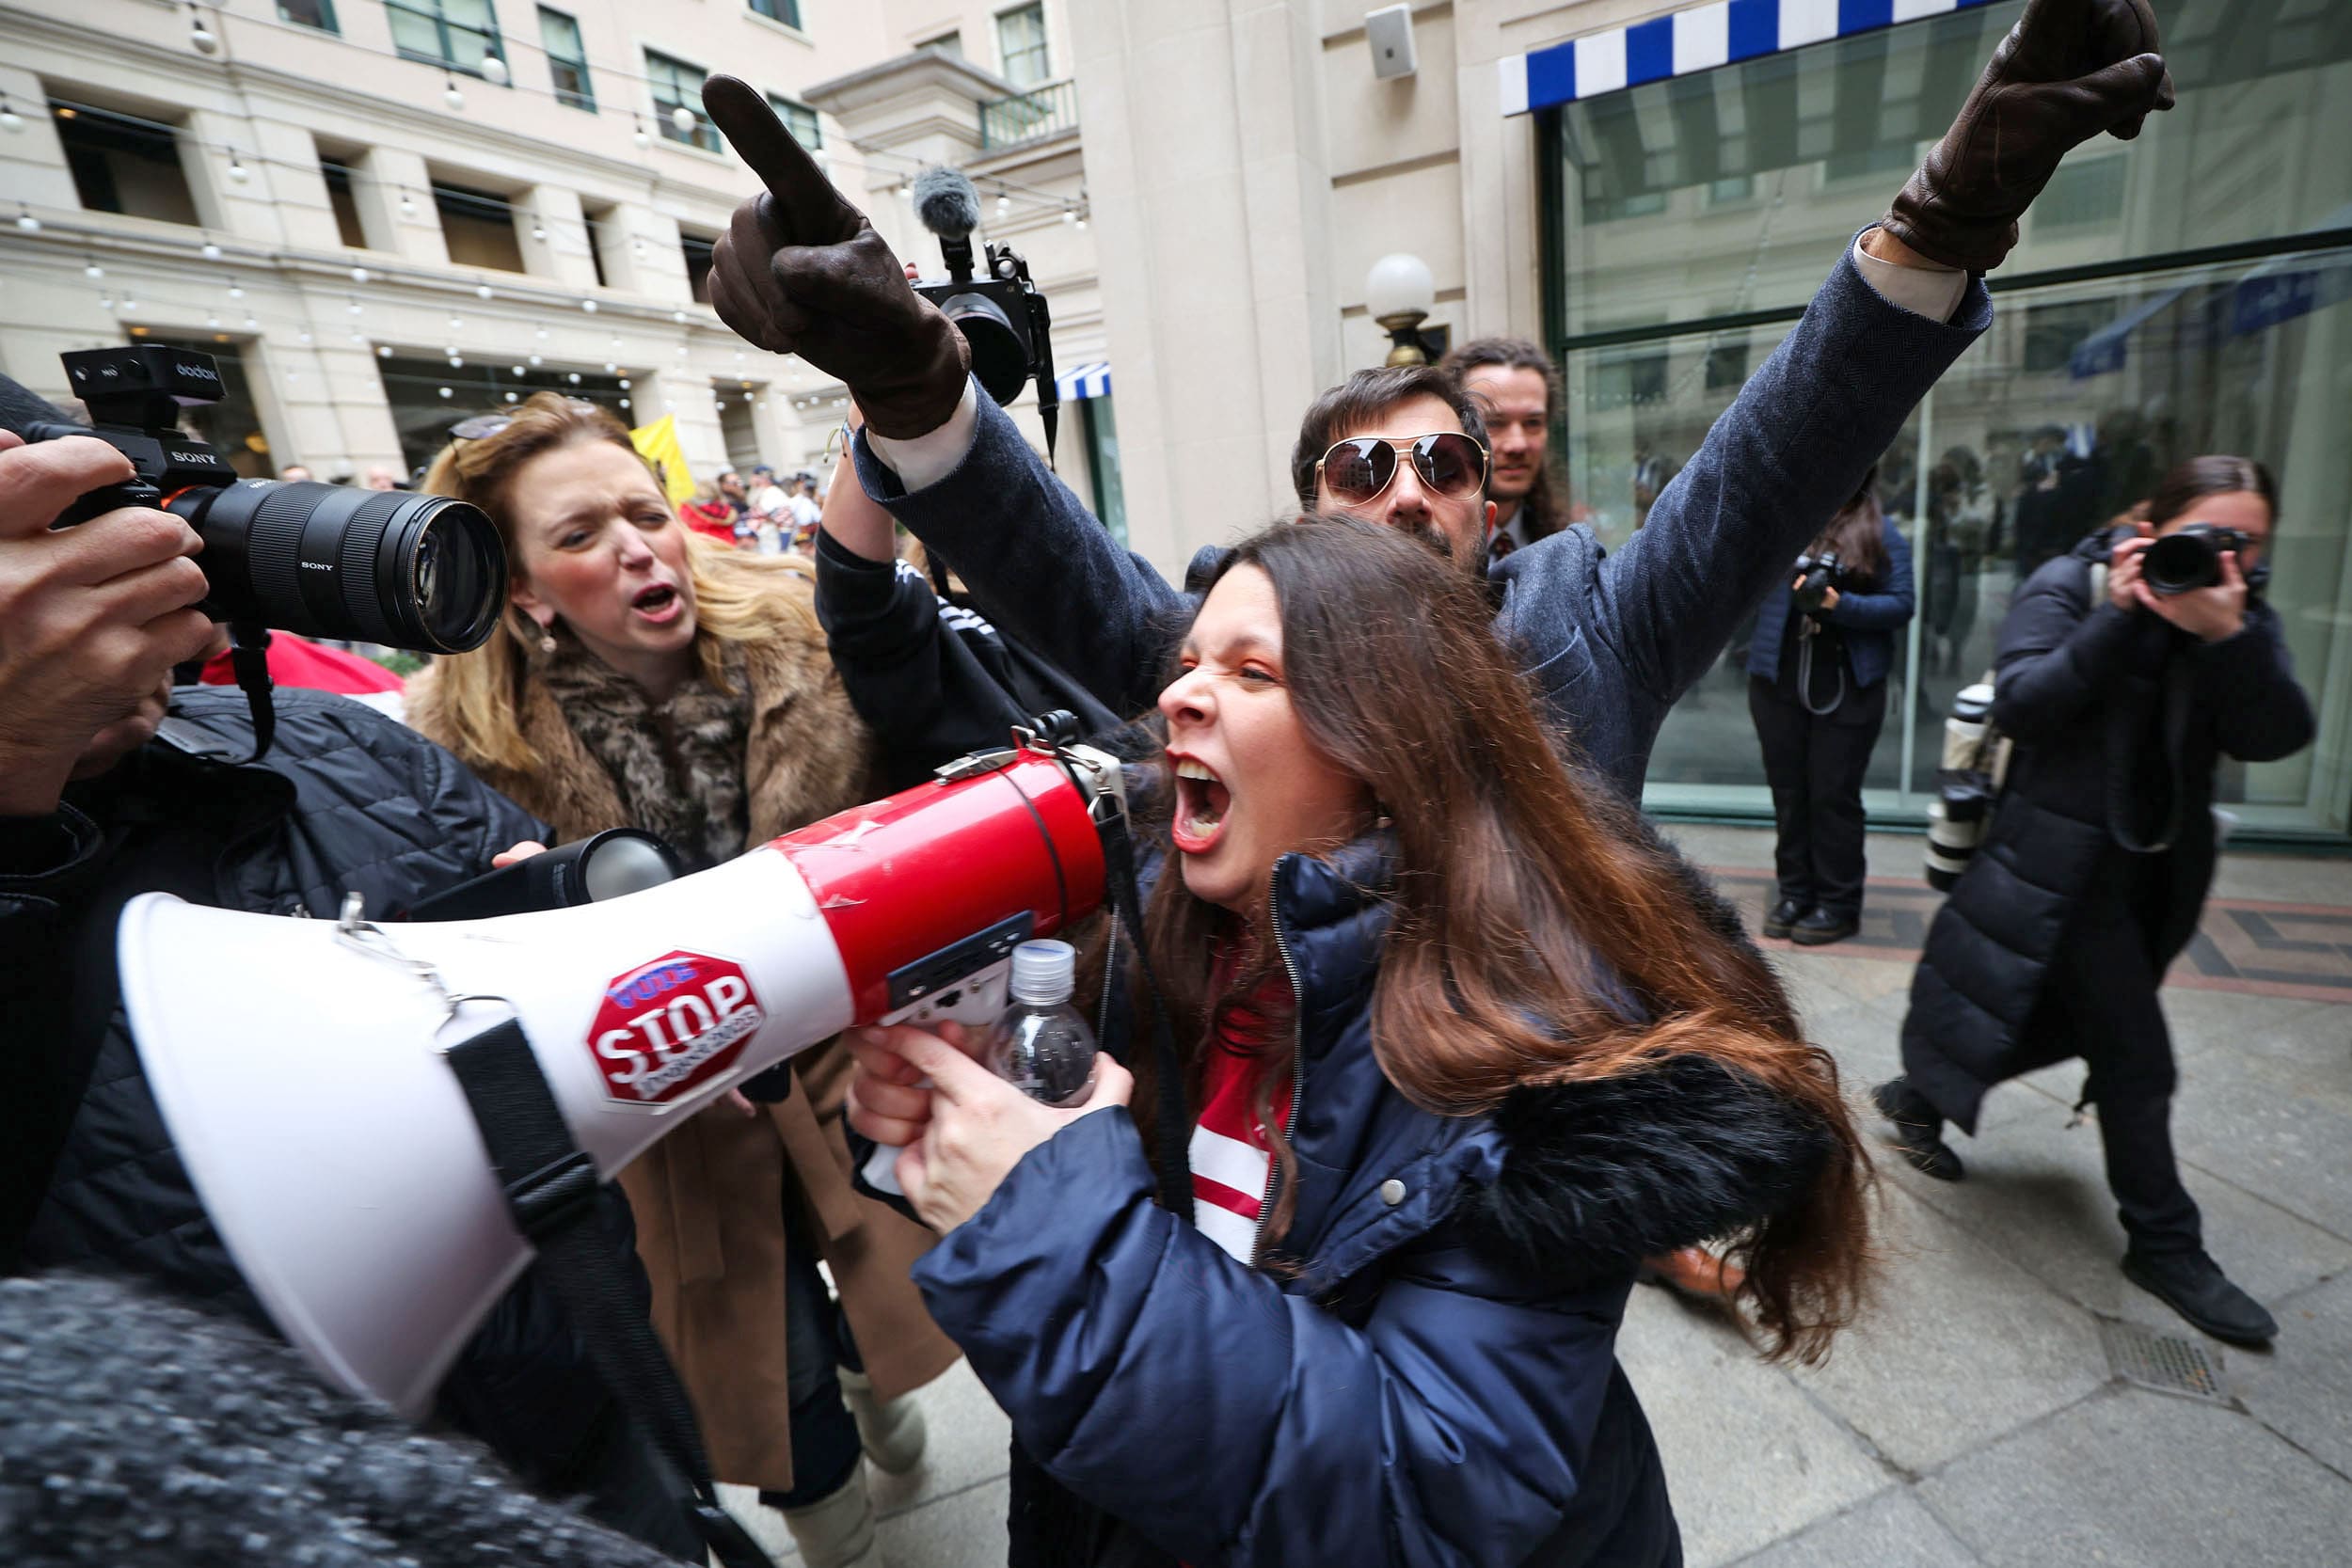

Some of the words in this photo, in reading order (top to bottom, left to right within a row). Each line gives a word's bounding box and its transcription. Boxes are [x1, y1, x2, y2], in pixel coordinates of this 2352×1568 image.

[171, 451, 217, 466] SONY
[301, 561, 334, 572] SONY
[596, 975, 748, 1085] STOP
